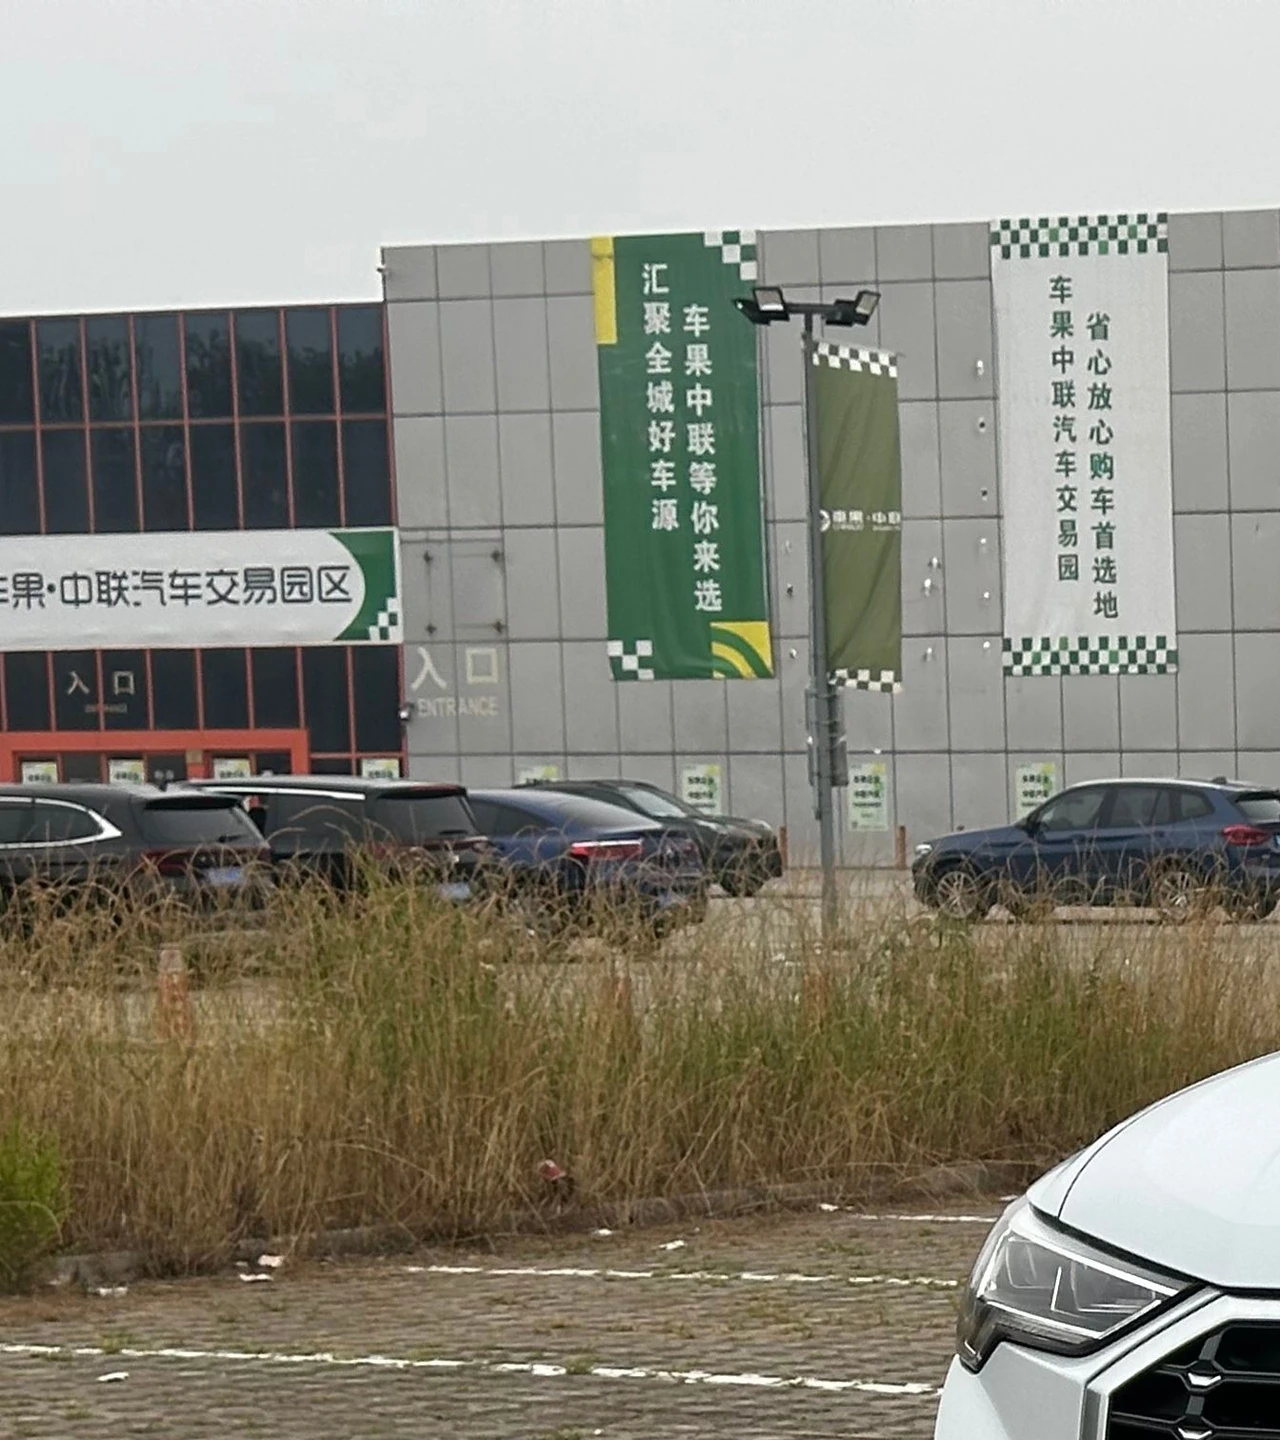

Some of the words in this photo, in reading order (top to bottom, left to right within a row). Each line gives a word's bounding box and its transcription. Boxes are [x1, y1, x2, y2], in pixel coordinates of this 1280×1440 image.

[642, 263, 680, 531] 汇聚全城好车源
[683, 303, 723, 612] 车果中联等你来选
[1049, 275, 1080, 581] 车果中联汽车交易园
[1086, 311, 1119, 619] 省心放心购车首选地
[0, 565, 352, 609] 果·中联汽车交易园区
[68, 670, 136, 695] 入口
[411, 646, 498, 691] 入口
